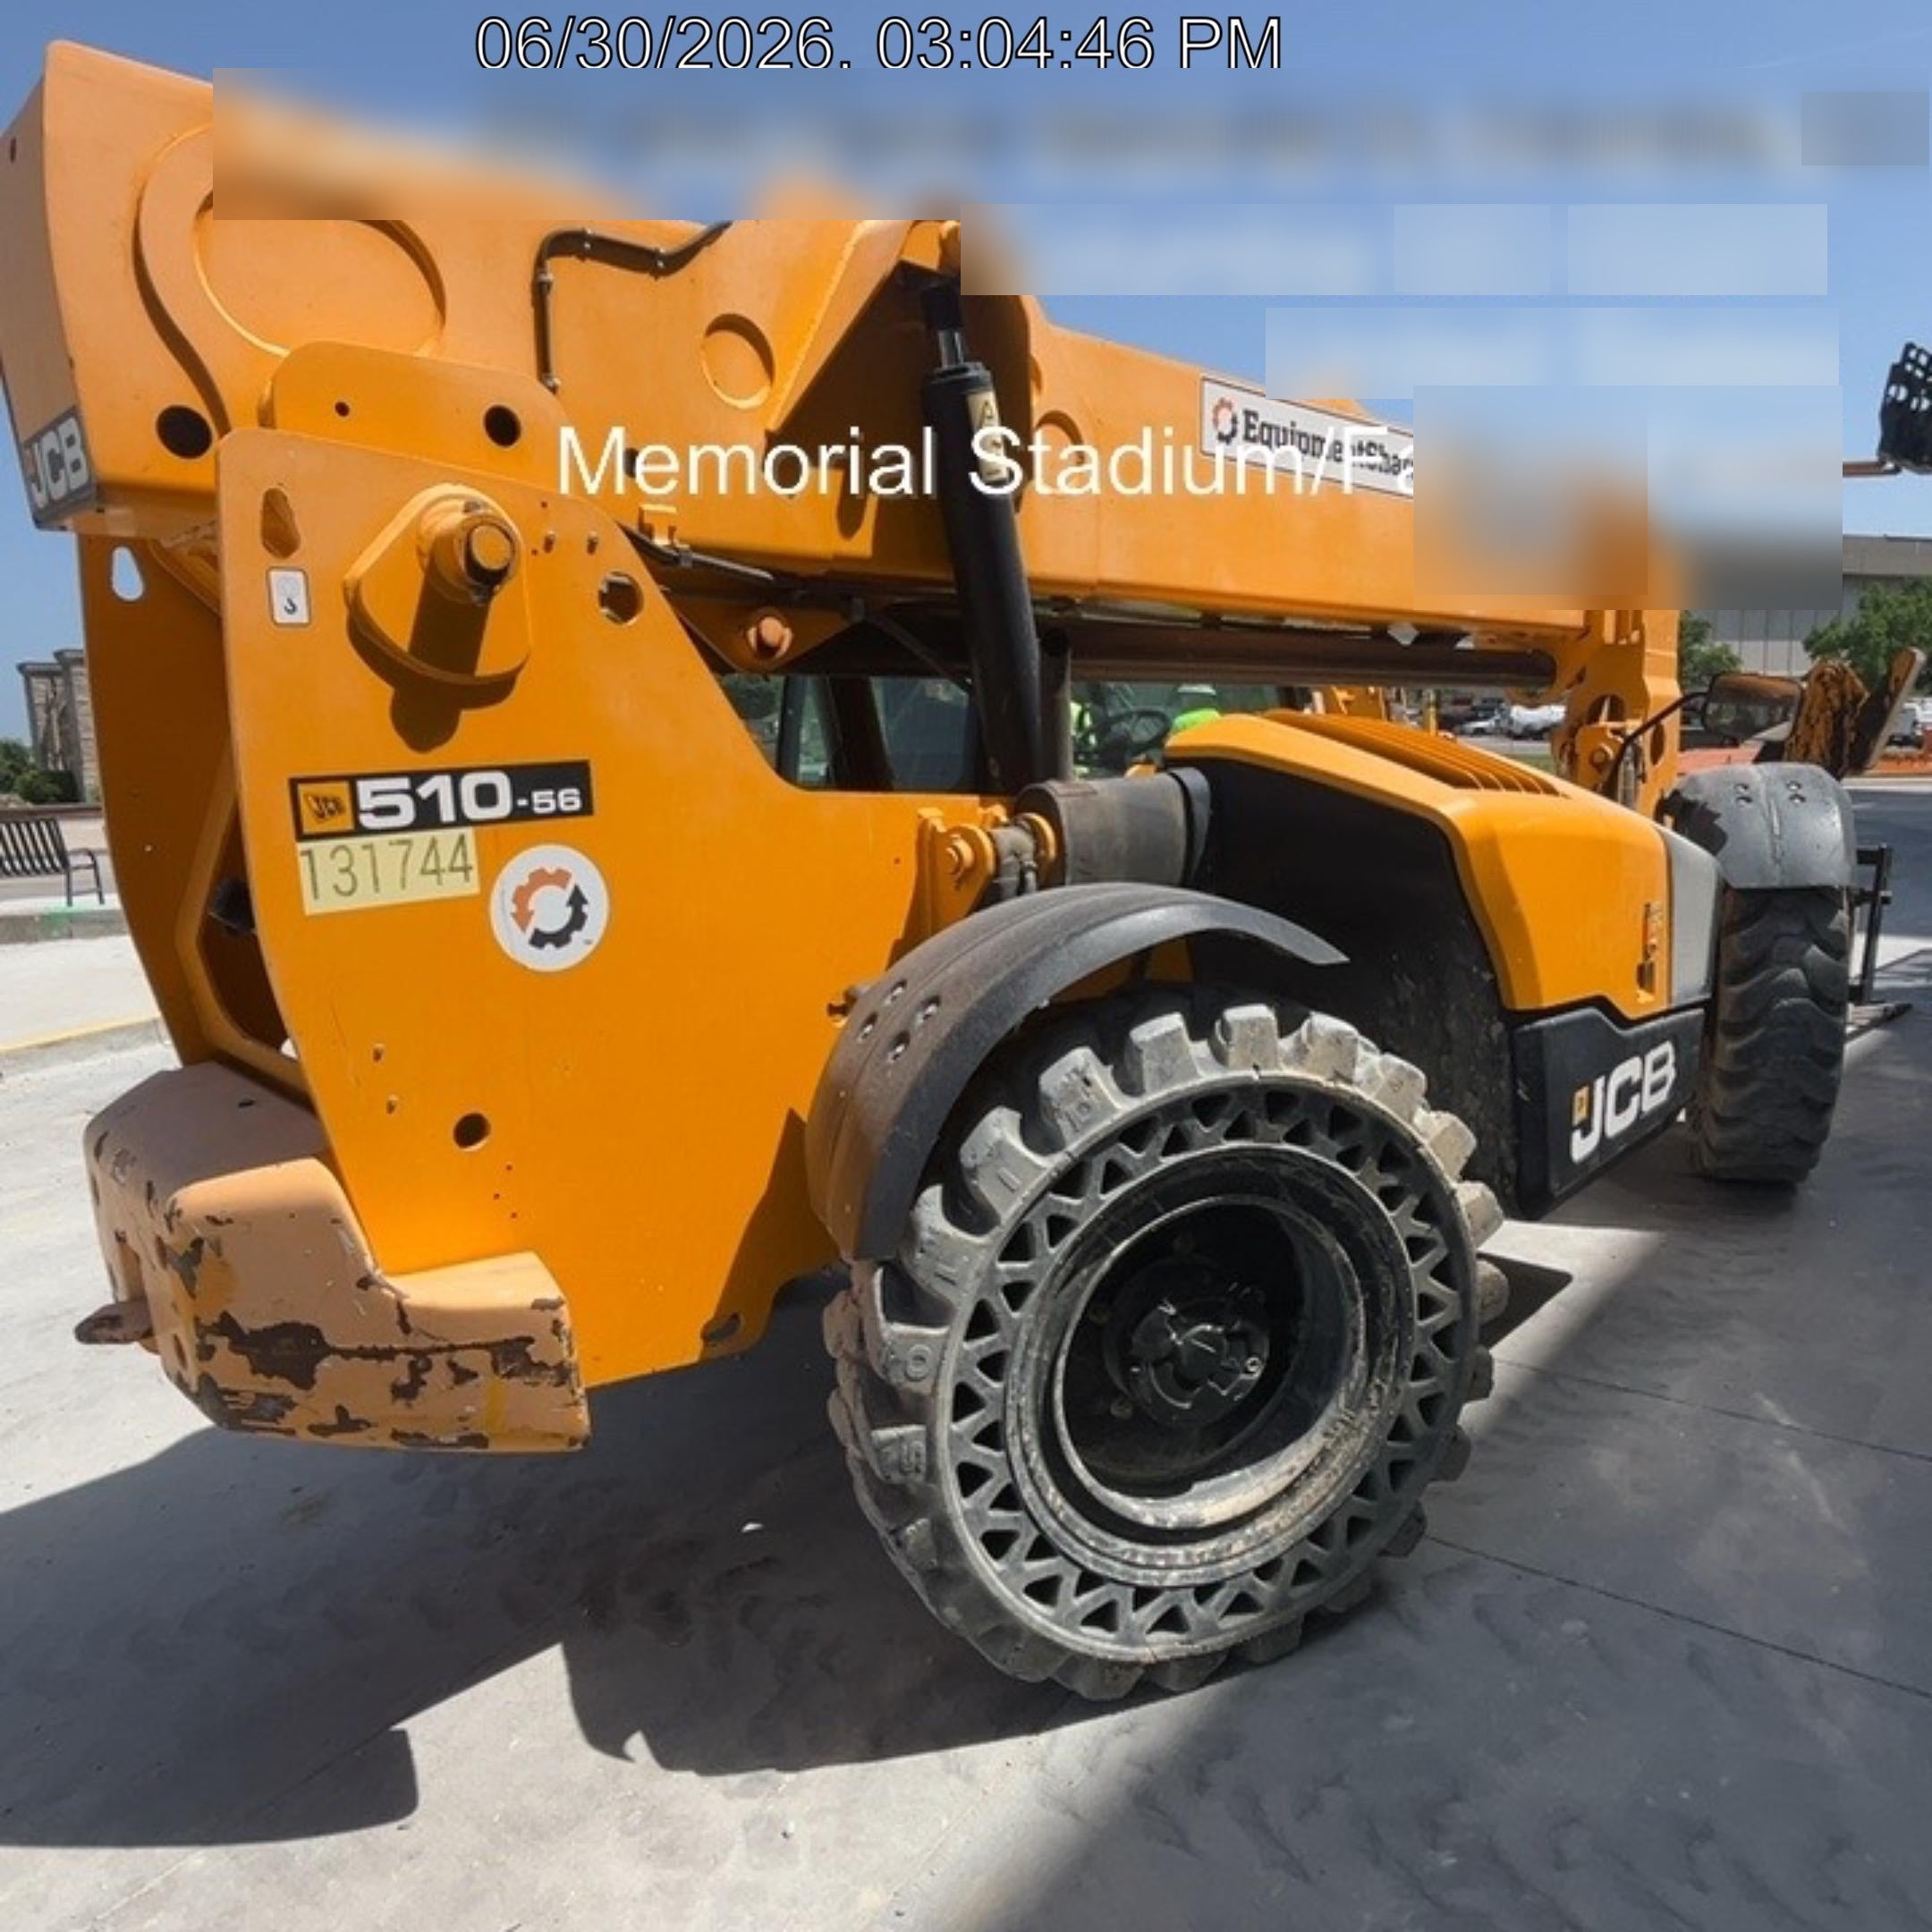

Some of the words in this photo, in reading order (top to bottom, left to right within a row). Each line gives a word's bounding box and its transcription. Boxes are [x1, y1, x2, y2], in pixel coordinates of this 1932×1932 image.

[30, 417, 89, 509] JCB
[357, 770, 581, 830] 510-56
[301, 834, 473, 900] 131744
[1571, 1040, 1676, 1164] JCB
